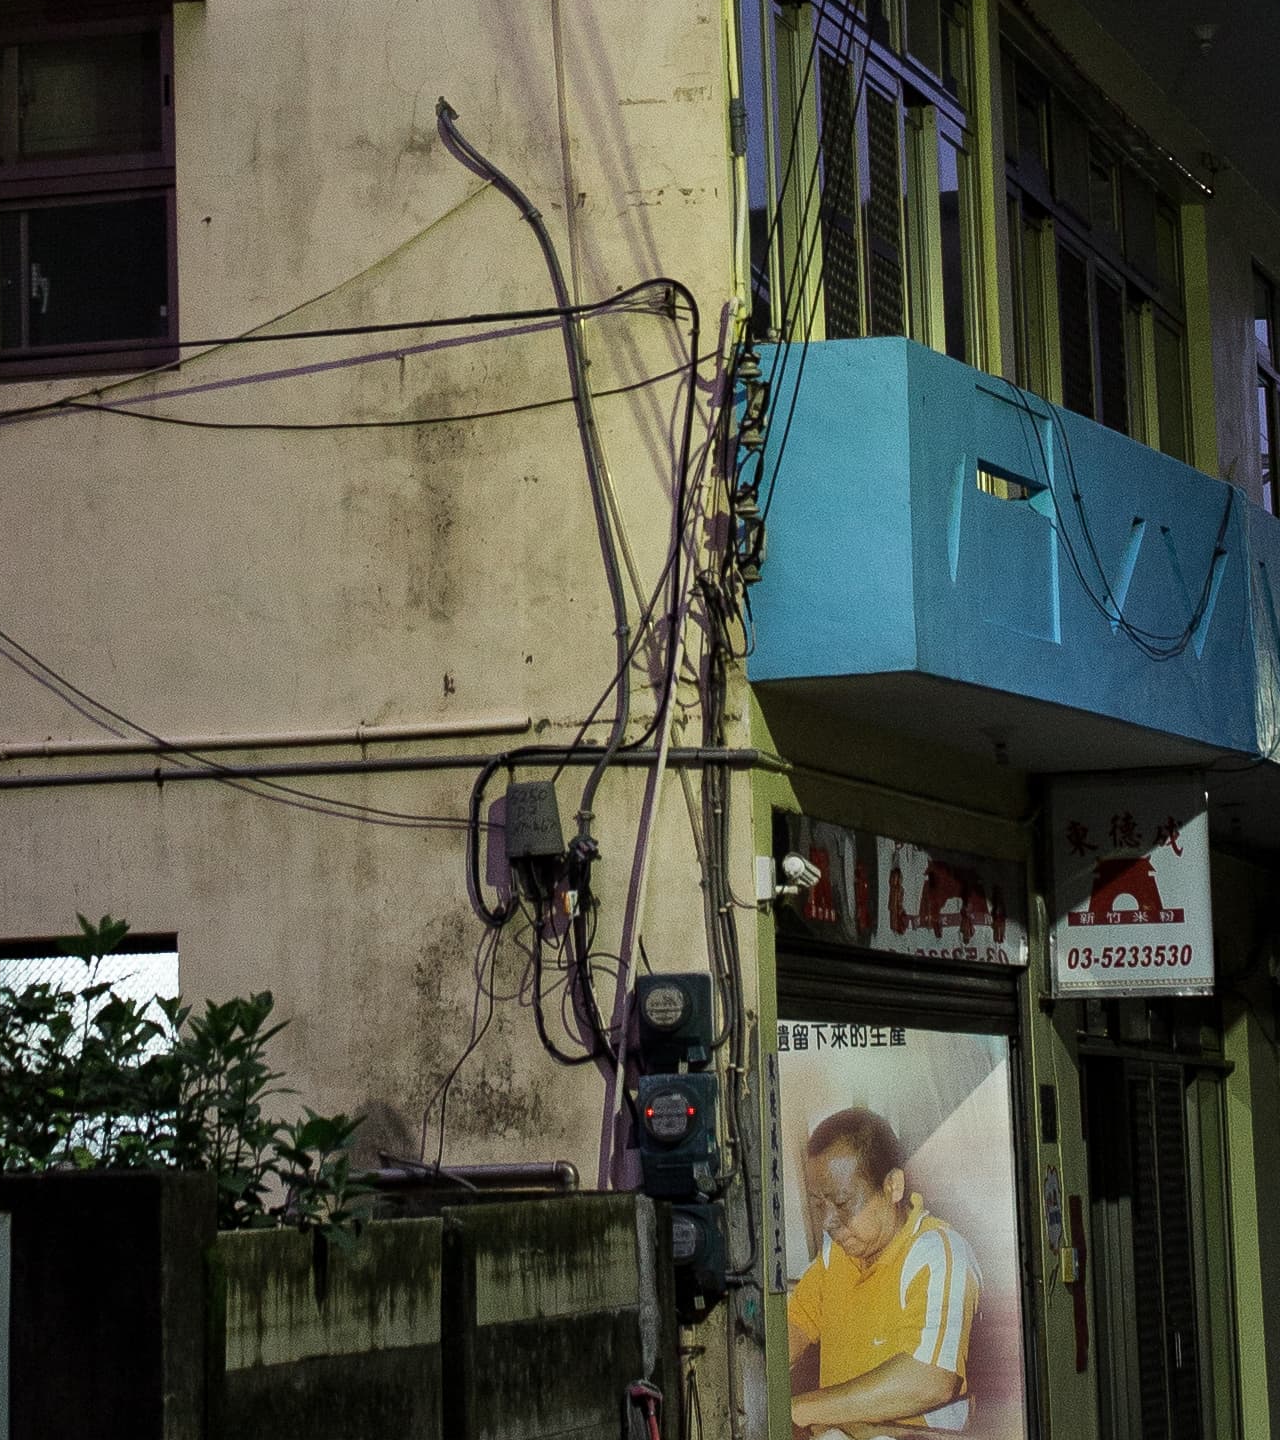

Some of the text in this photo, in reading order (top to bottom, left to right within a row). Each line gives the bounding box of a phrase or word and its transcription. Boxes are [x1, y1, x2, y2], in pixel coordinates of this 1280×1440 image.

[1065, 811, 1184, 857] 東德成
[1079, 910, 1175, 925] 新竹米粉
[1066, 945, 1193, 970] 03-5233530
